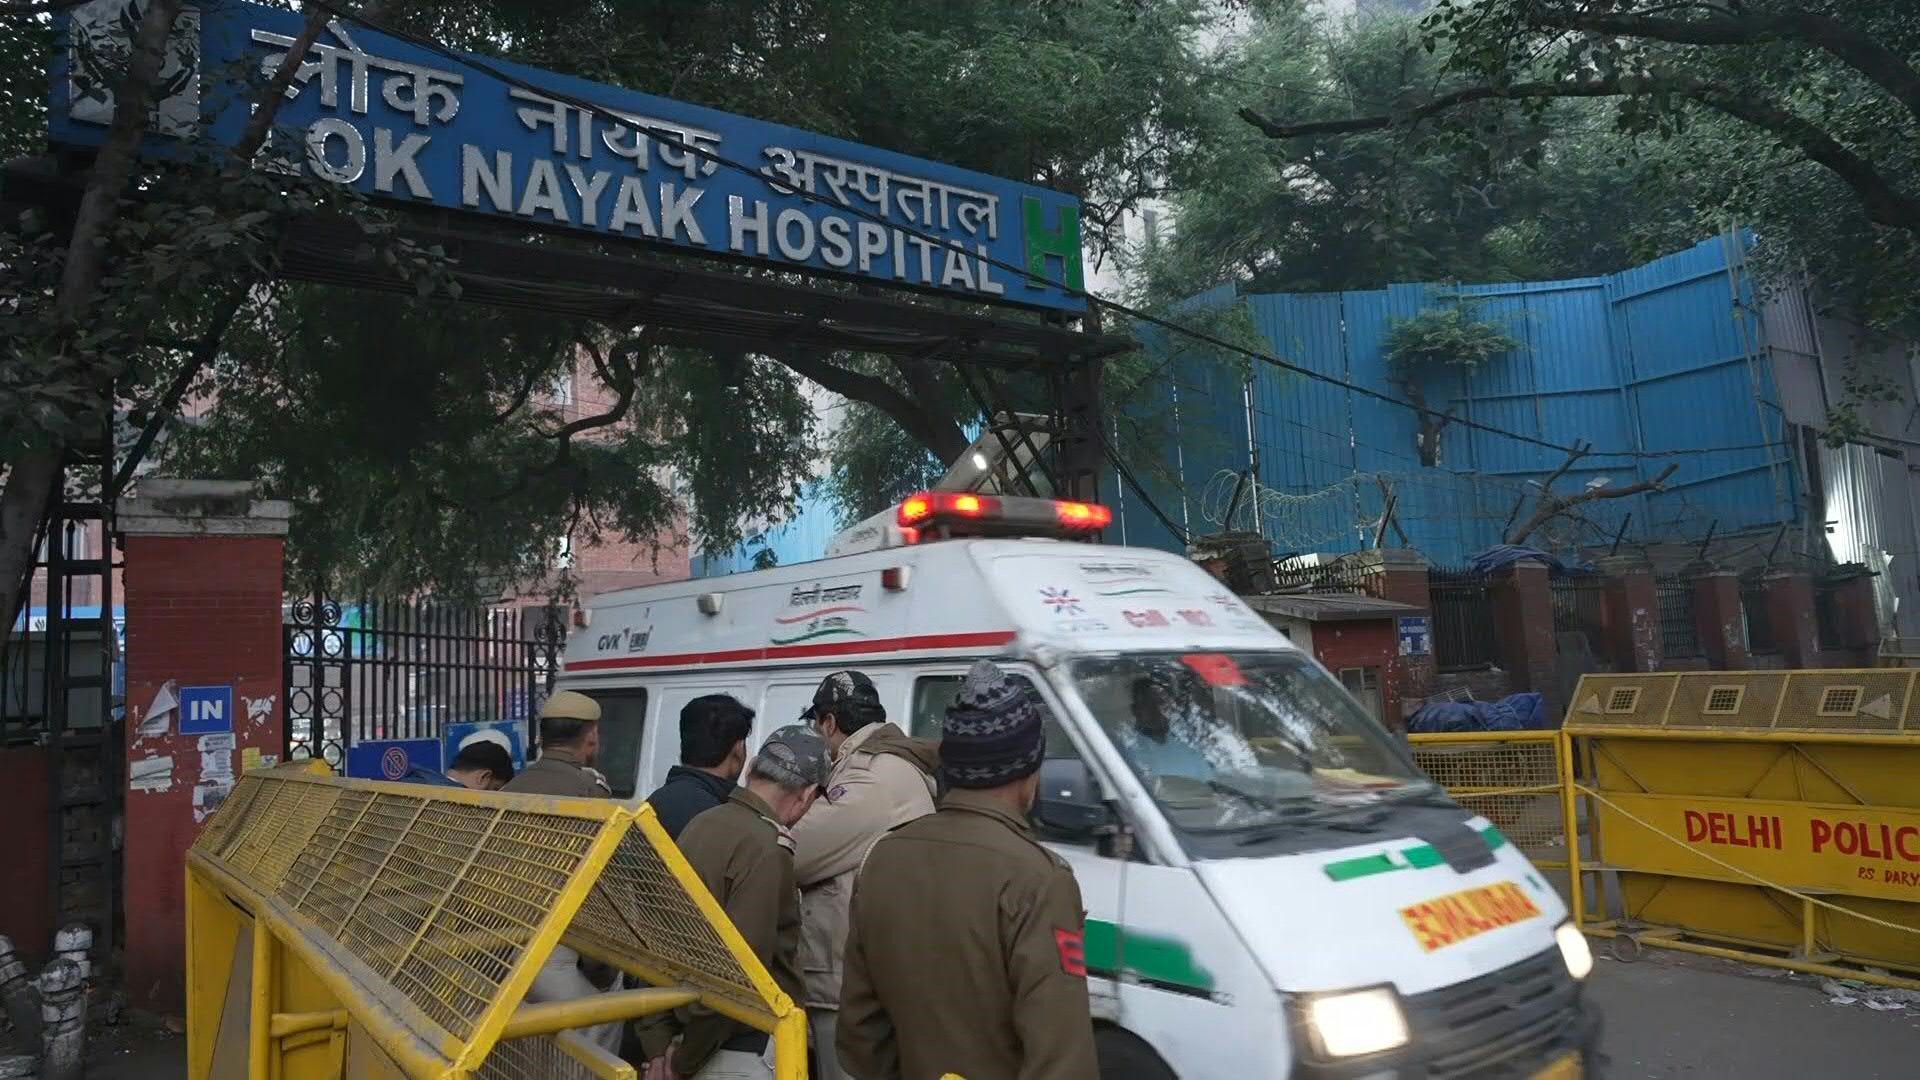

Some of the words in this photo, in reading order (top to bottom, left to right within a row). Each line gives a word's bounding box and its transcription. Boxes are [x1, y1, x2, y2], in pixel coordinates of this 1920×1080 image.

[252, 16, 464, 126] लोक
[510, 87, 721, 180] नायक
[760, 147, 999, 240] अस्पताल
[463, 144, 708, 246] NAYAK
[729, 195, 1004, 294] HOSPITAL
[1023, 196, 1085, 293] H
[190, 700, 223, 721] IN
[1684, 810, 1783, 850] DELHI
[1884, 869, 1920, 888] DARY
